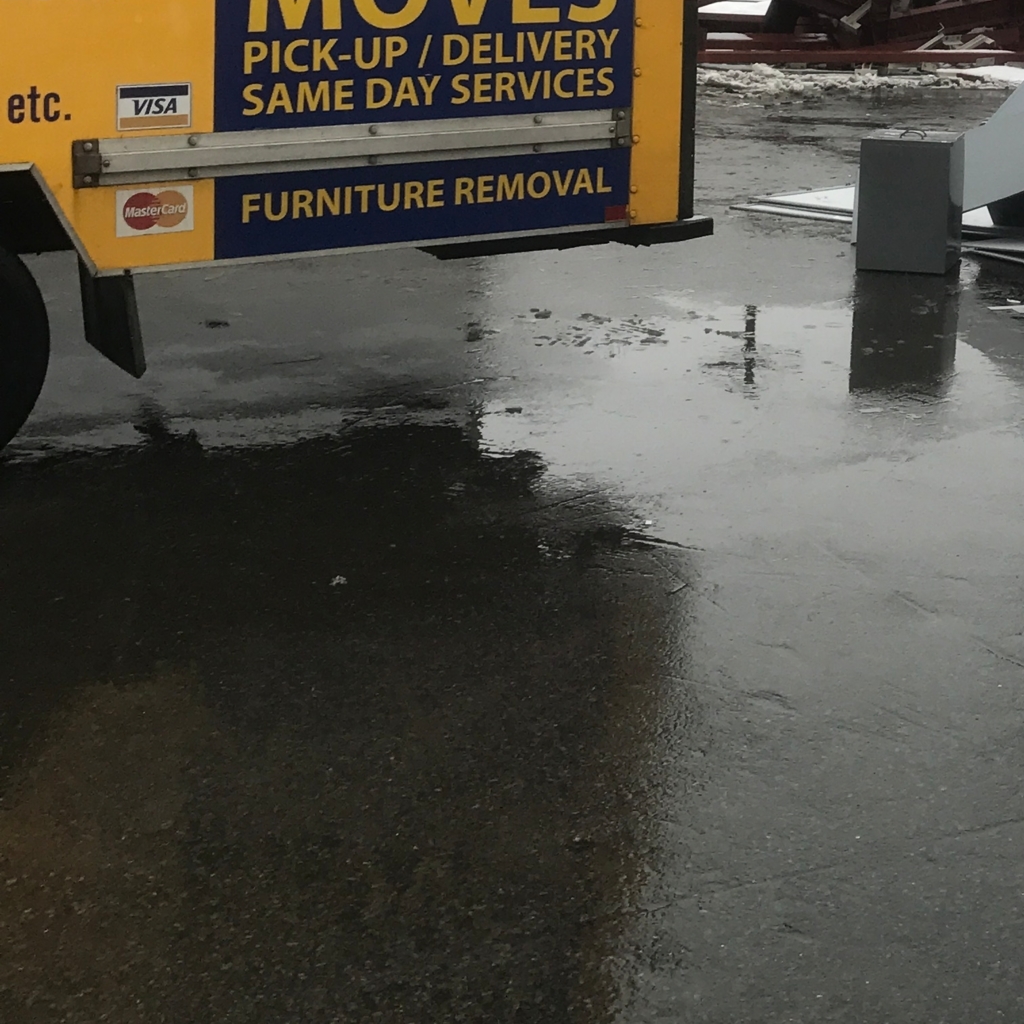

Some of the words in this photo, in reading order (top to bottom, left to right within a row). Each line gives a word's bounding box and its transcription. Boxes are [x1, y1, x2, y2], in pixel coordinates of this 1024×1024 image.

[243, 36, 408, 74] PICK-UP
[442, 28, 619, 66] DELIVERY
[7, 85, 72, 124] etc.
[131, 97, 178, 116] VISA
[242, 79, 354, 116] SAME
[365, 75, 440, 109] DAY
[451, 66, 615, 104] SERVICES
[124, 202, 187, 218] MasterCard
[242, 180, 444, 223] FURNITURE
[454, 167, 611, 205] REMOVAL
